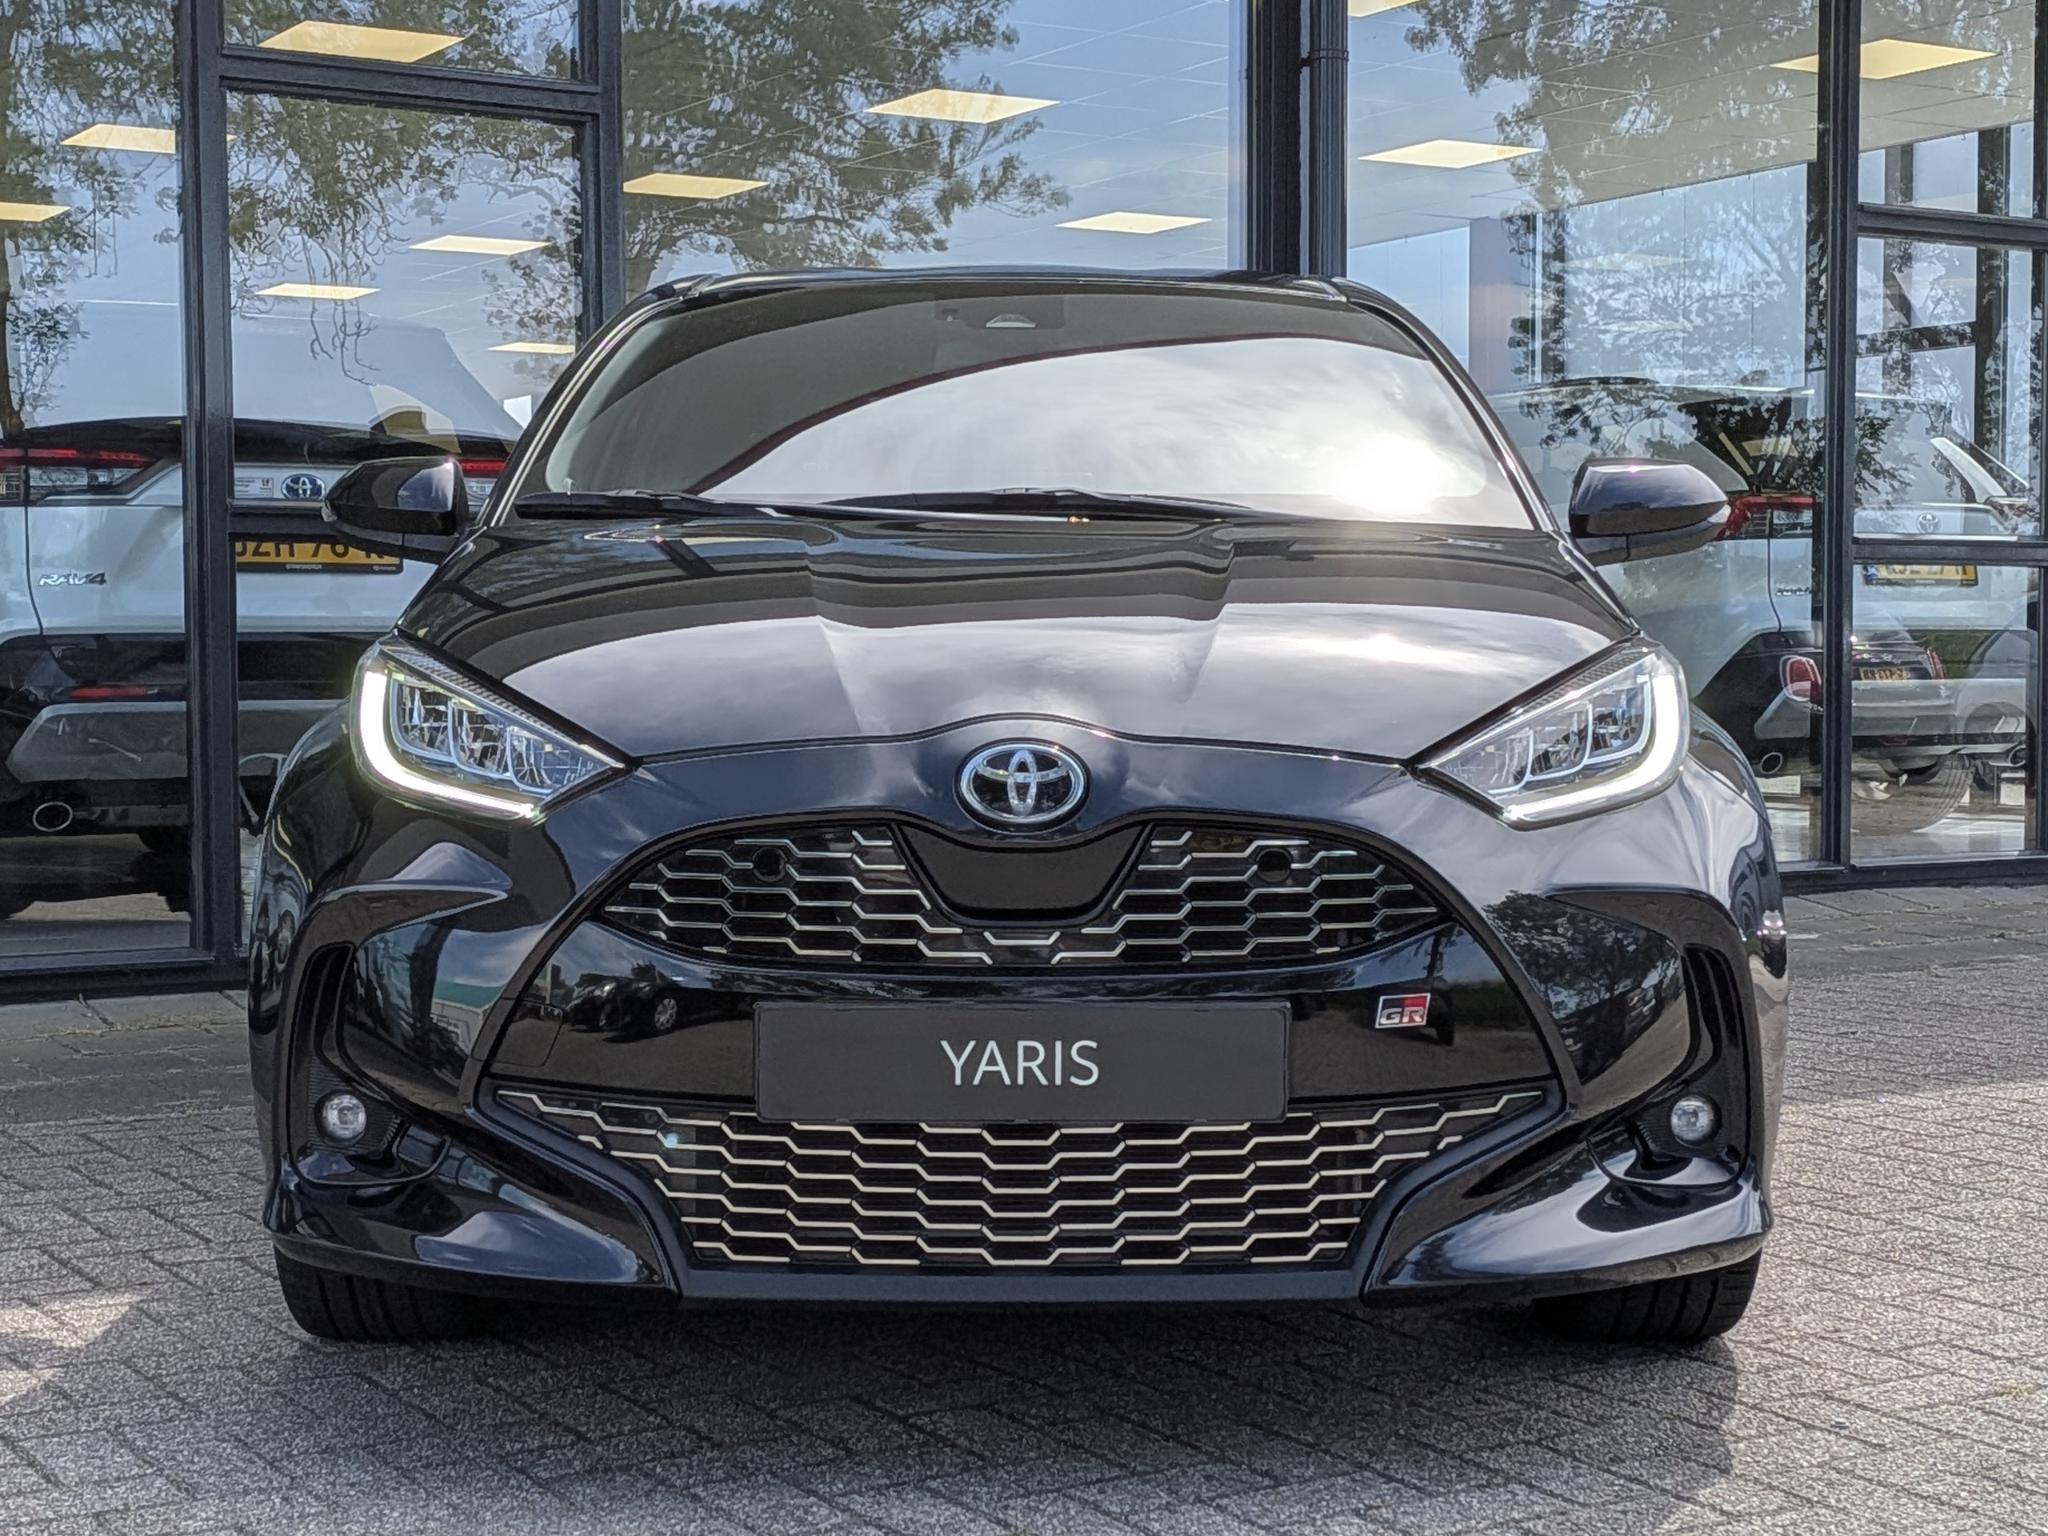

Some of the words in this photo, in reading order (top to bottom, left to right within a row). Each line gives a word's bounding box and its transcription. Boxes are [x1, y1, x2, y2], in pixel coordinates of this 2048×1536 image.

[40, 571, 107, 586] RAV4
[1380, 1006, 1425, 1024] GR
[940, 1040, 1099, 1086] YARIS
